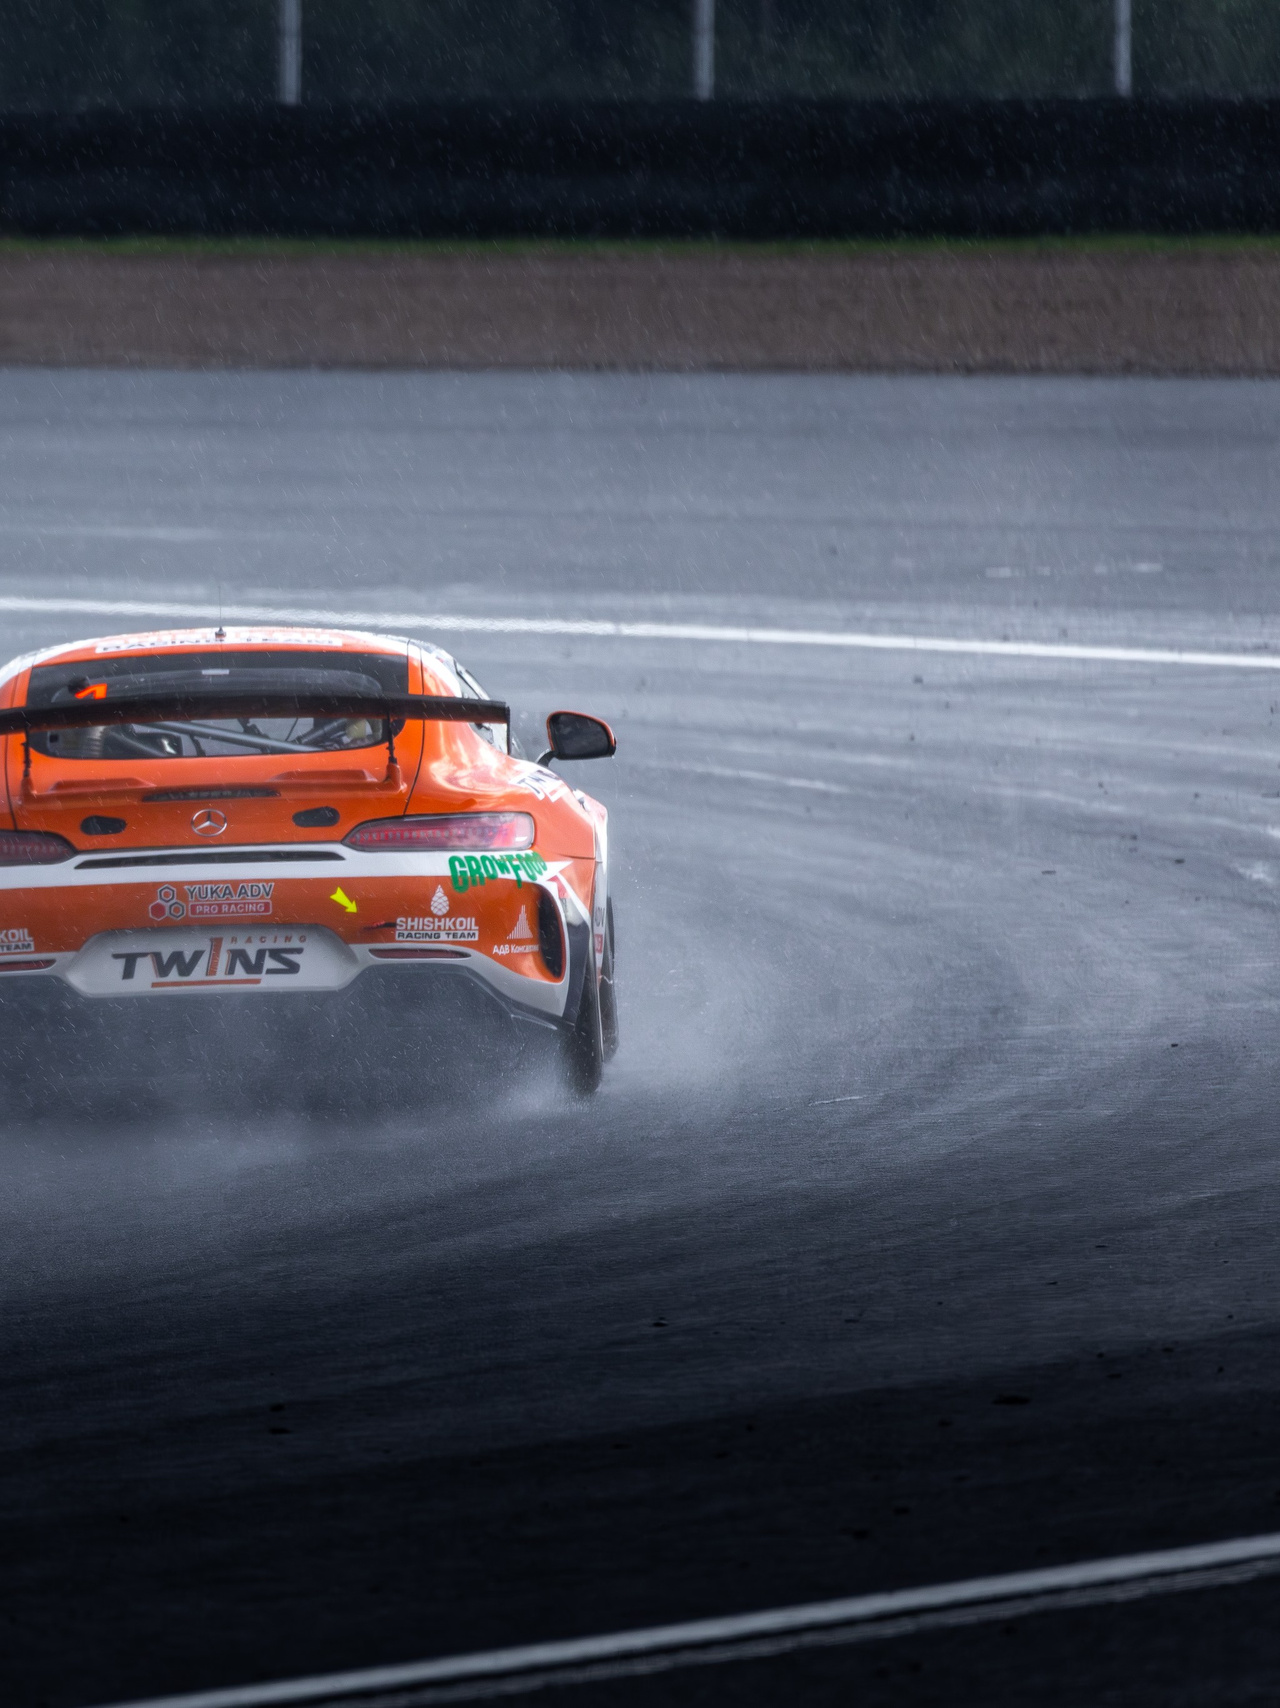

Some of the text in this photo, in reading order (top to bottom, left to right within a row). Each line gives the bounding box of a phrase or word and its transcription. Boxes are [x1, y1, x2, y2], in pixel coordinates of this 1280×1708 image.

[448, 852, 548, 893] GROWFOOD
[185, 883, 274, 900] YUKA ADV
[195, 902, 266, 914] PRO RACING
[394, 917, 479, 931] SHISHKOIL
[230, 935, 308, 944] RACING
[397, 931, 478, 940] RACING TEAM
[0, 942, 33, 952] TEAM
